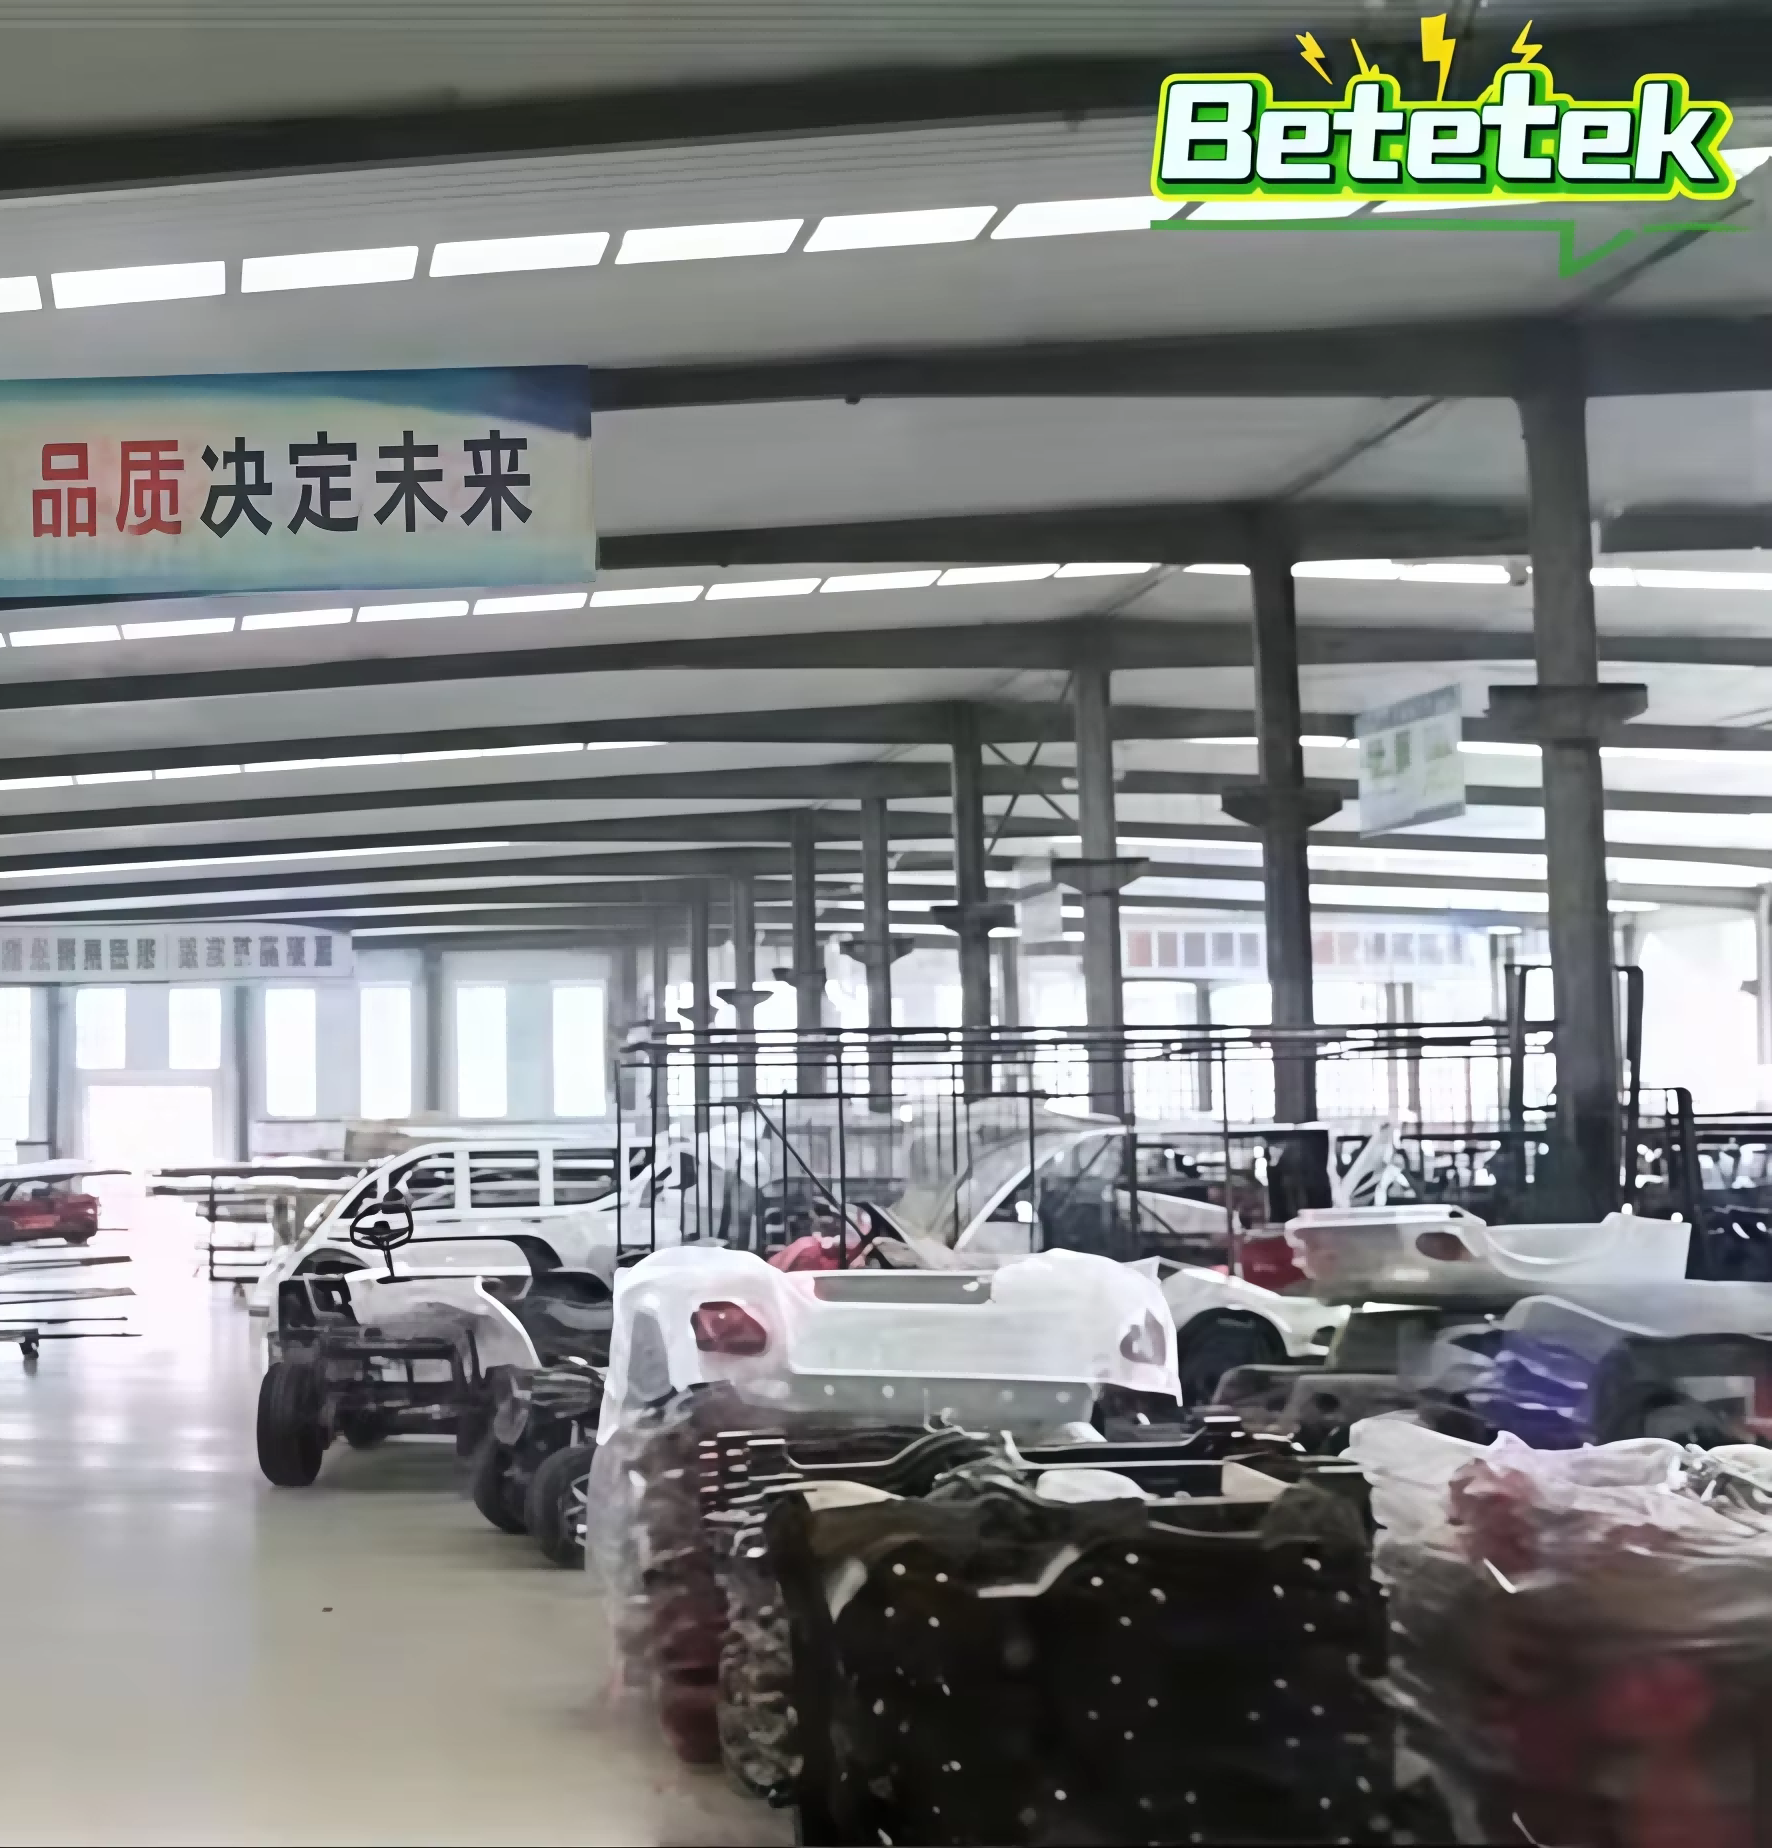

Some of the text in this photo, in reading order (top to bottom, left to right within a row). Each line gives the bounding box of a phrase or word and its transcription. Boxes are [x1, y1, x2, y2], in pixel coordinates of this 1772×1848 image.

[31, 429, 533, 539] 品质决定未来
